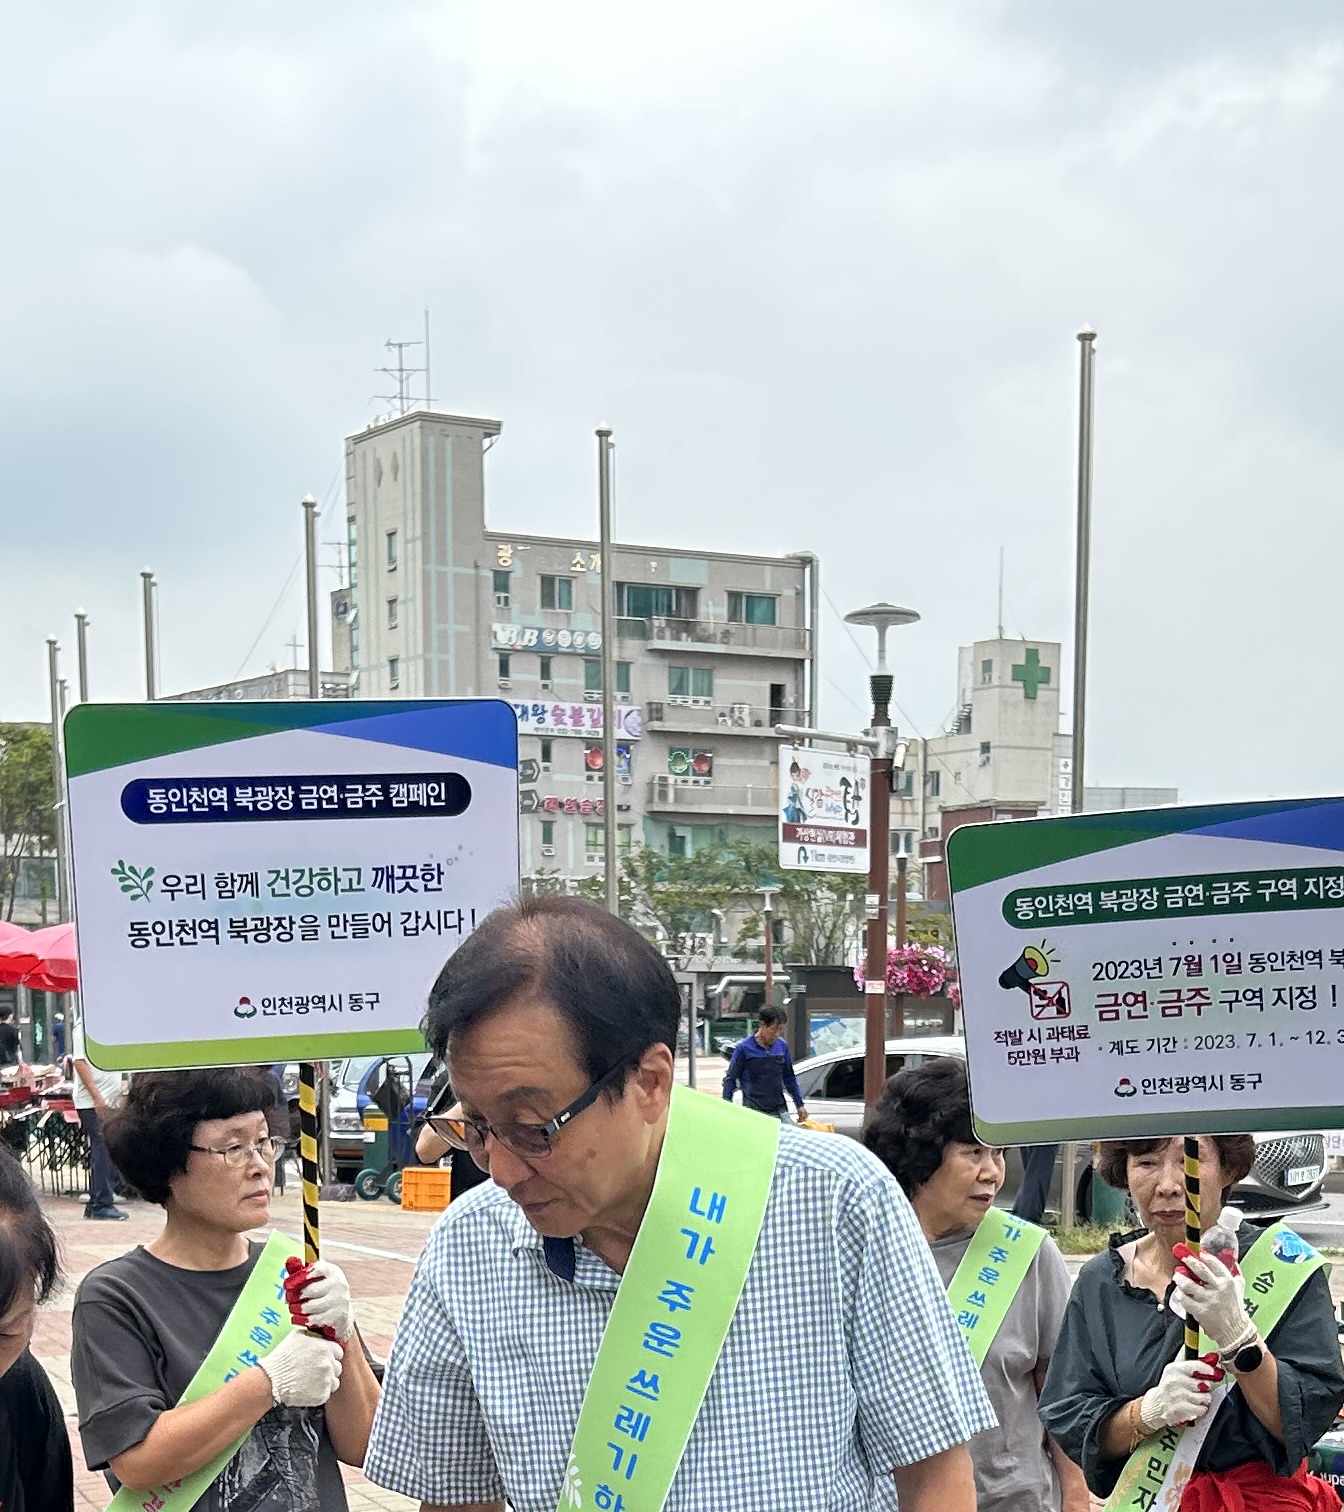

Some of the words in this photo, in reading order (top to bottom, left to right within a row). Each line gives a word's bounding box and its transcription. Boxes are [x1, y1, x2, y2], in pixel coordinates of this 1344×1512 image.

[146, 785, 228, 814] 동인천역
[233, 785, 295, 812] 북광장
[298, 782, 385, 810] 금연·금주
[388, 780, 446, 808] 캠페인
[159, 871, 206, 901] 우리
[214, 869, 260, 899] 함께
[266, 864, 365, 898] 건강하고
[371, 862, 445, 895] 깨끗한
[1014, 892, 1094, 921] 동인천역
[1098, 886, 1159, 915] 북광장
[1163, 880, 1253, 910] 금연·금주
[1256, 876, 1298, 905] 구역
[127, 918, 220, 949] 동인천역
[226, 913, 321, 944] 북광장을
[327, 911, 393, 940] 만들어
[1092, 957, 1164, 983] 2023년
[1168, 953, 1204, 979] 7월
[1209, 951, 1243, 975] 1일
[1247, 948, 1323, 975] 동인천역
[260, 993, 343, 1017] 인천광역시
[348, 991, 381, 1012] 동구
[1093, 985, 1213, 1024] 금연·금주
[1218, 984, 1264, 1013] 구역
[1271, 982, 1317, 1010] 지정
[993, 1027, 1024, 1047] 적발
[1045, 1022, 1092, 1043] 과태료
[1108, 1039, 1141, 1058] 계도
[1146, 1036, 1178, 1055] 기간
[1007, 1049, 1047, 1067] 5만원
[1049, 1045, 1081, 1065] 부과
[1141, 1073, 1224, 1097] 인천광역시
[1229, 1072, 1264, 1093] 동구
[680, 1186, 727, 1266] 내가
[642, 1280, 695, 1358] 주운
